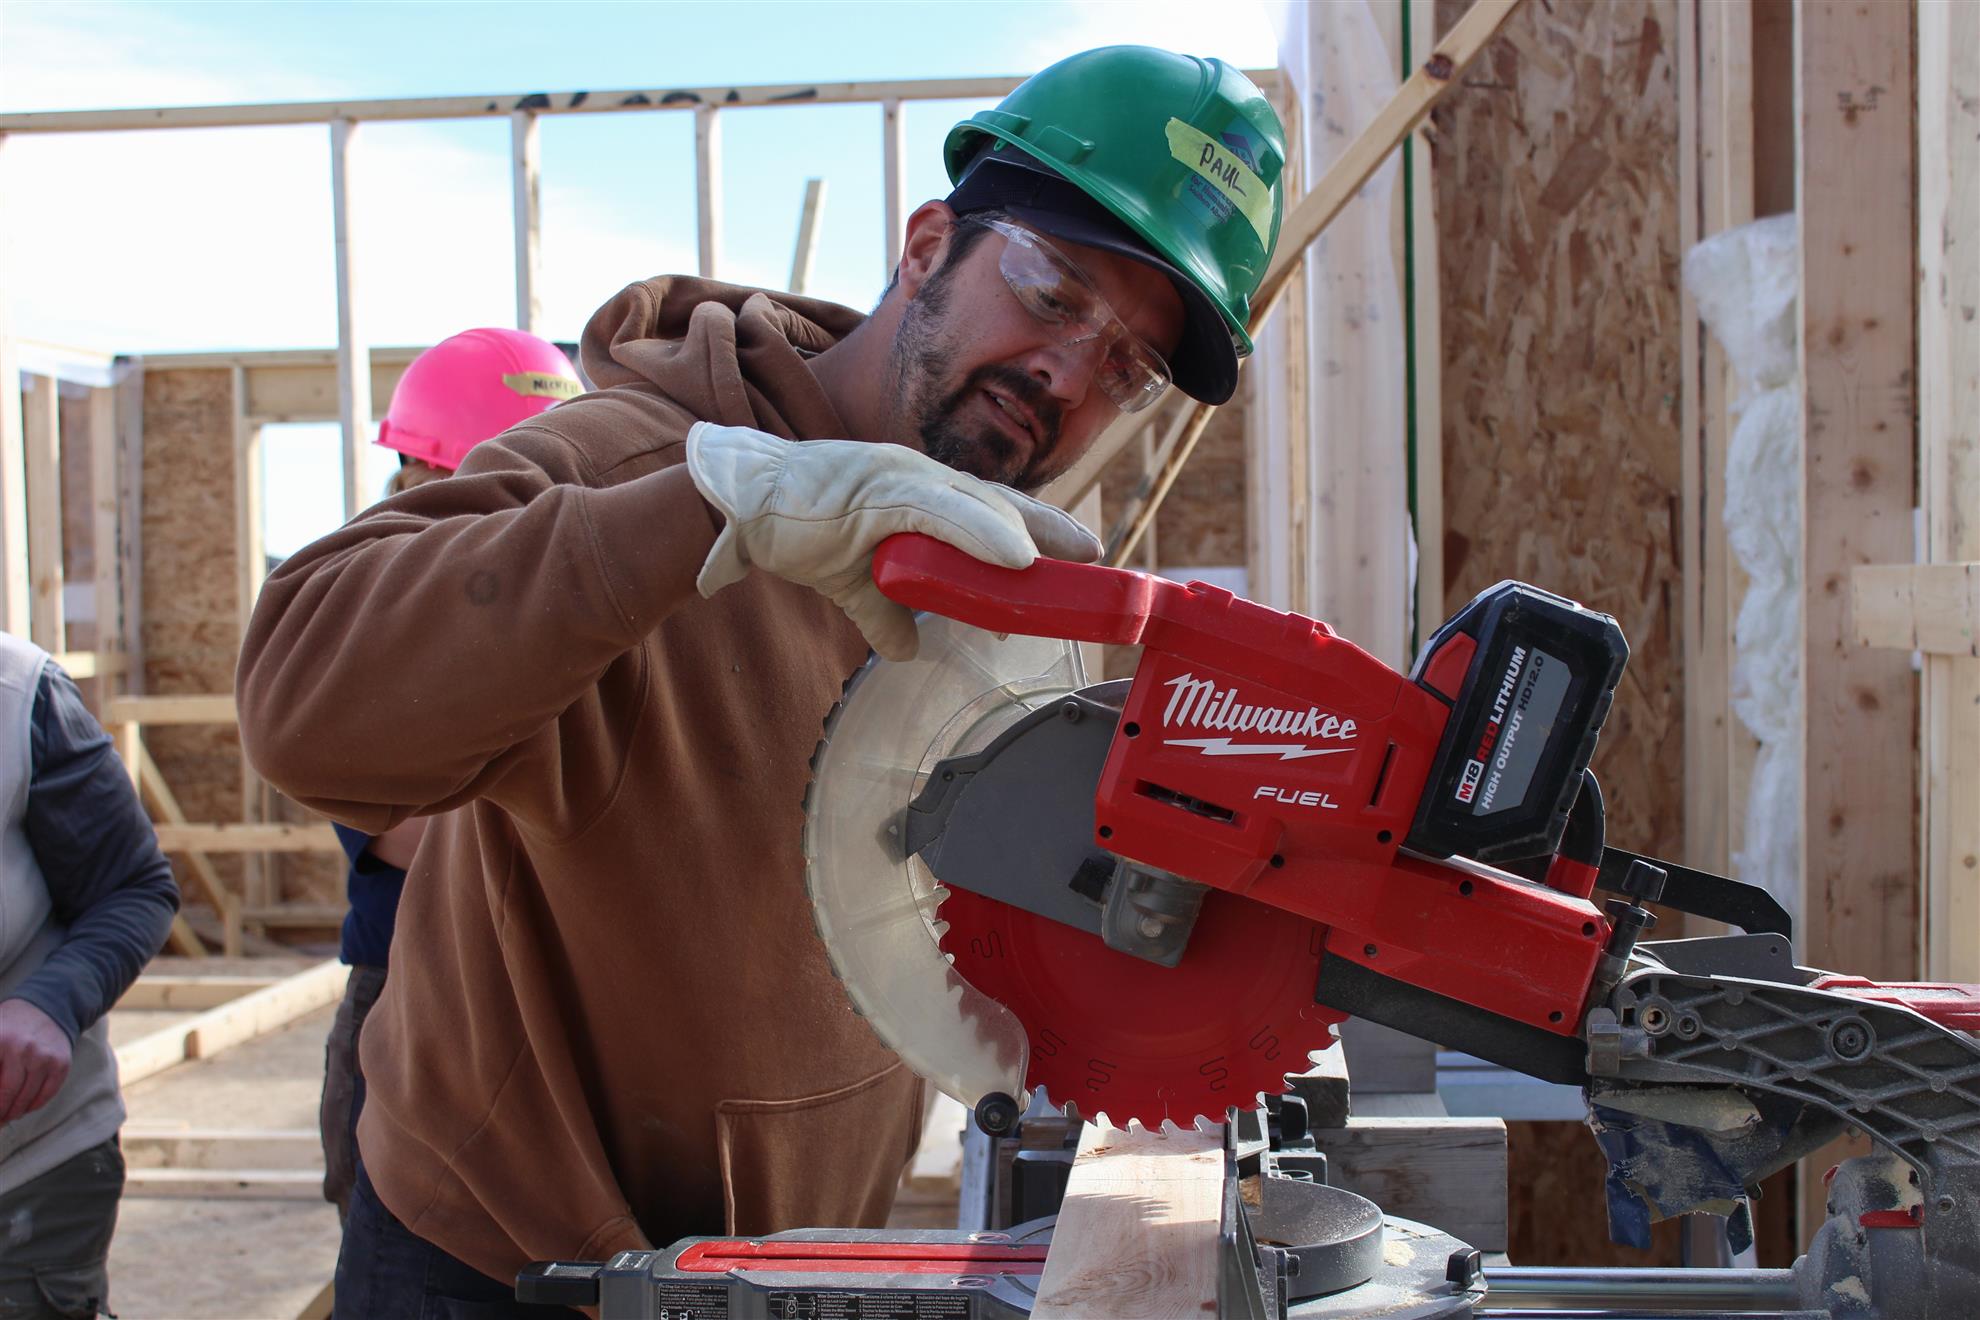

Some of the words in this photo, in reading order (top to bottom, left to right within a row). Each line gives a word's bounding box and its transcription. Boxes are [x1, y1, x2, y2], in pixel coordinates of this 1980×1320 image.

[1199, 142, 1248, 198] PAUL
[1163, 672, 1358, 740] Milwaukee
[1481, 770, 1502, 810] HIGH
[1496, 710, 1523, 770] OUTPUT
[1518, 655, 1544, 711] HD12.0
[1253, 786, 1339, 809] FUEL
[1457, 761, 1482, 802] M18
